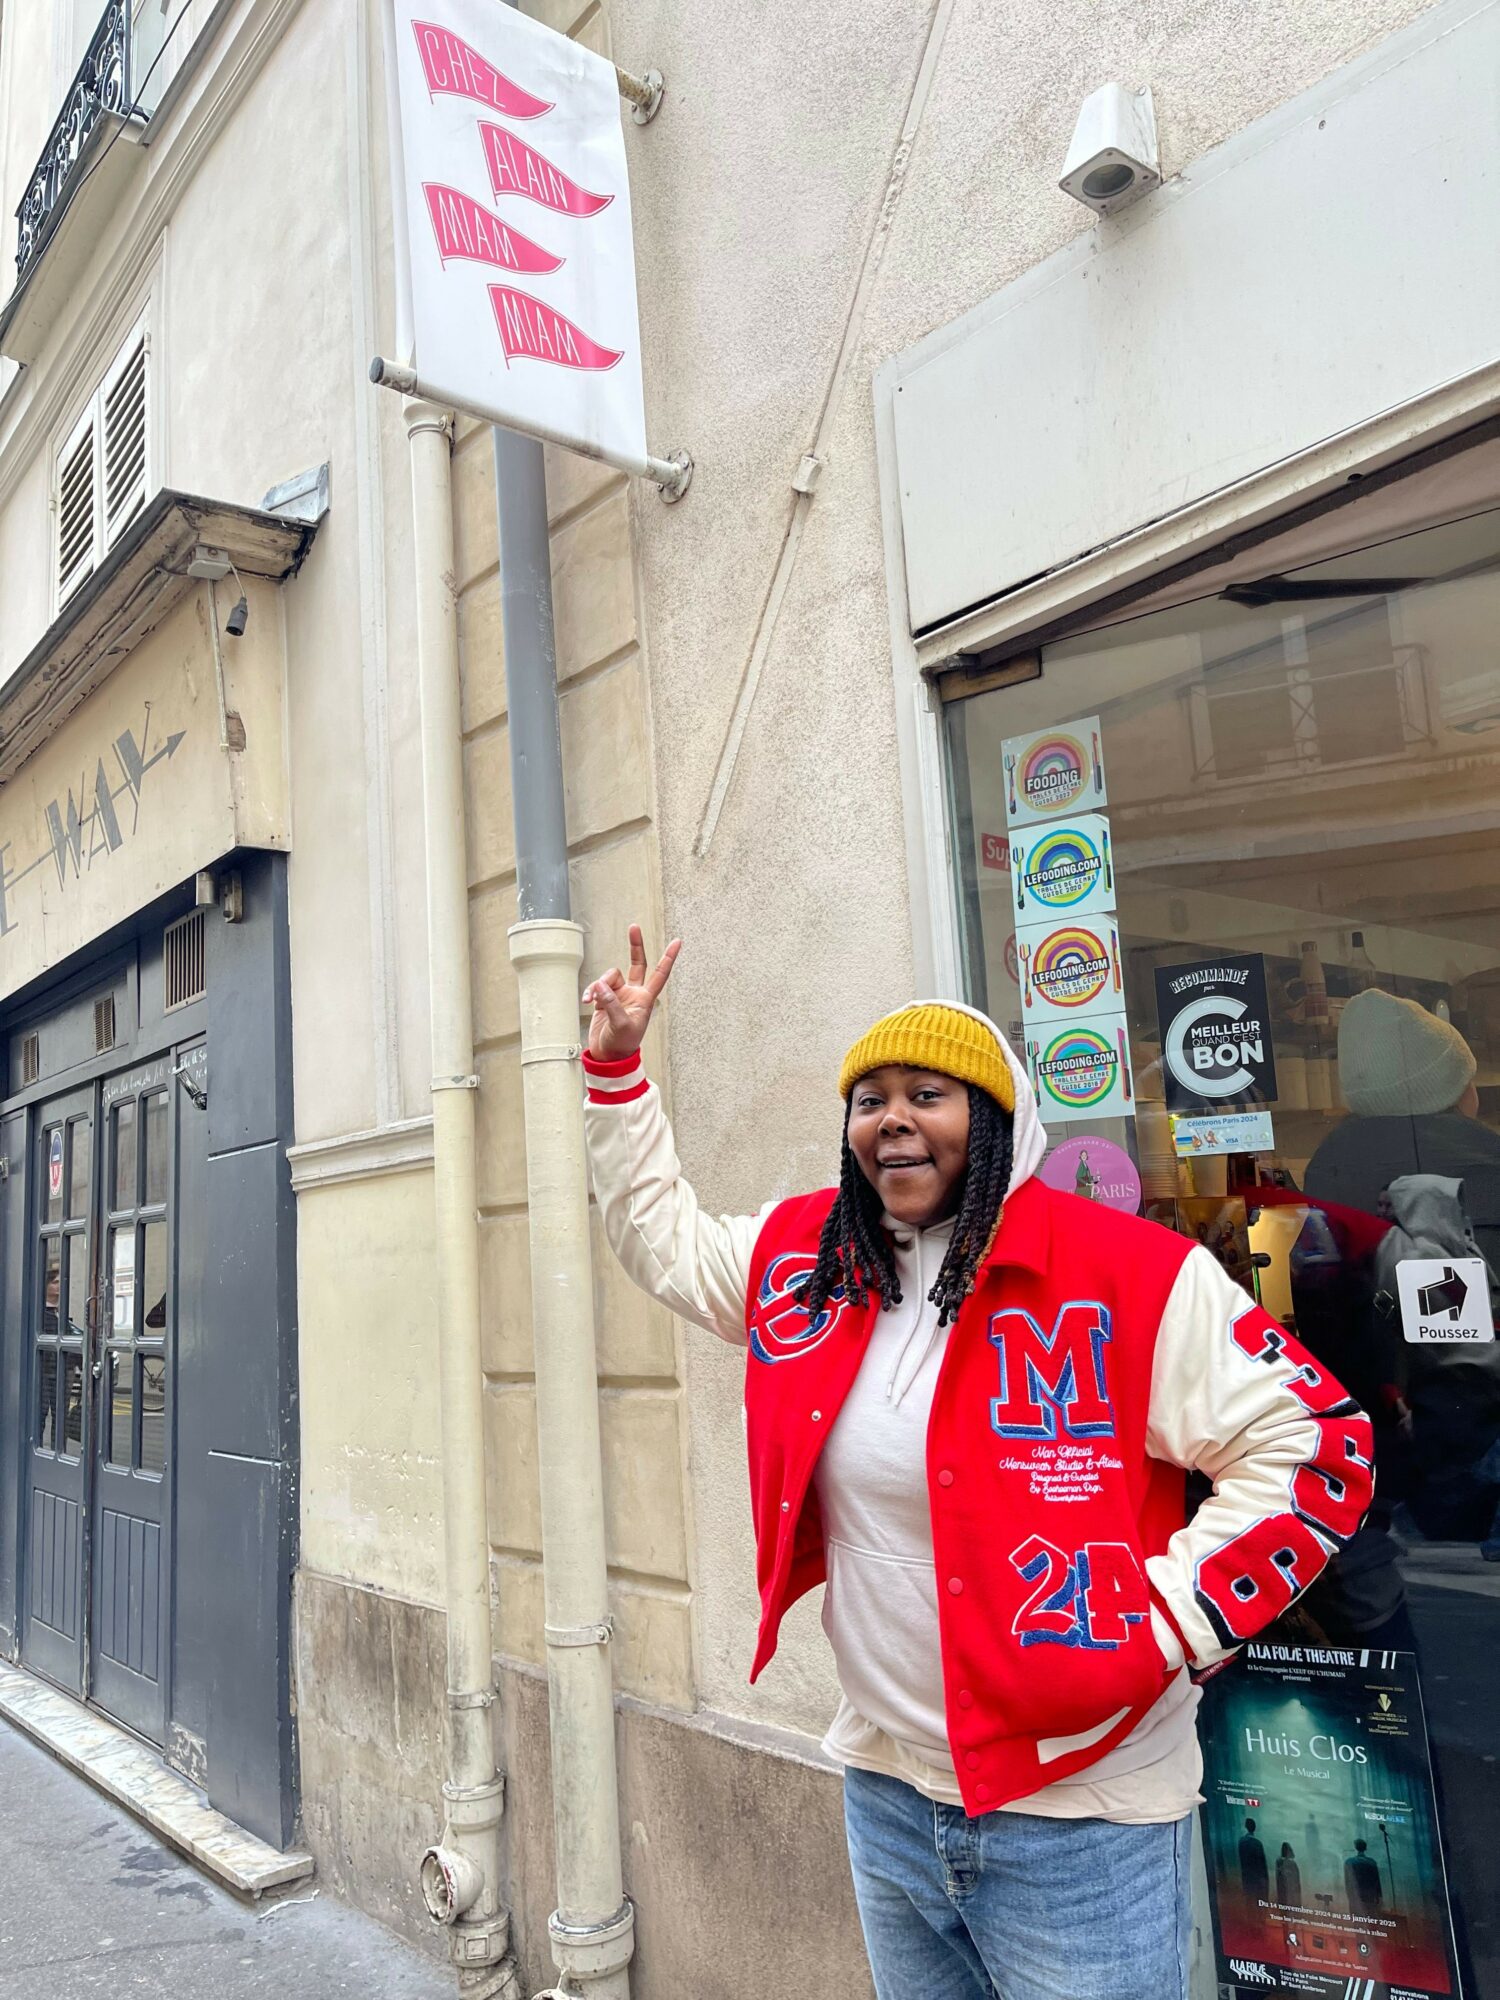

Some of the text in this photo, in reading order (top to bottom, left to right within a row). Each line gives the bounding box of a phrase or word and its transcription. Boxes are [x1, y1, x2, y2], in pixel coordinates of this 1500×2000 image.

[424, 31, 505, 108] CHEZ
[492, 129, 568, 209] ALAIN
[438, 191, 519, 268] MIAM
[501, 293, 581, 364] MIAM
[1027, 770, 1078, 791] FOODING
[44, 702, 151, 893] WAY
[1034, 796, 1053, 807] GUIDE
[1026, 857, 1099, 886] LEFOODING.COM
[1037, 874, 1096, 894] TABLES DE GENRE
[1042, 884, 1082, 899] GUIDE 2020
[1033, 958, 1108, 985] LEFOODING.COM
[1045, 982, 1070, 993] TABLES
[1082, 974, 1105, 985] GENRE
[1051, 984, 1091, 998] GUIDE 2019
[1190, 1020, 1261, 1039] MEILLEUR
[1192, 1031, 1261, 1048] QUAND C'EST
[1165, 996, 1256, 1098] C
[1192, 1040, 1265, 1070] BON
[1040, 1051, 1116, 1074] LEFOODING.COM
[1054, 1075, 1078, 1084] TABLES
[1089, 1070, 1110, 1080] GENRE
[1061, 1082, 1082, 1091] GUIDE
[1187, 1118, 1222, 1128] Célébrons
[1222, 1116, 1240, 1125] Paris
[1240, 1115, 1258, 1123] 2024
[1091, 1182, 1136, 1199] PARIS
[1419, 1326, 1480, 1339] Poussez
[988, 1300, 1116, 1441] M
[1031, 1445, 1094, 1459] Man Official
[999, 1457, 1052, 1471] Menswear
[1054, 1459, 1085, 1471] Studio
[1029, 1482, 1041, 1494] By
[1009, 1534, 1149, 1649] 24
[1247, 1643, 1257, 1659] A
[1257, 1645, 1272, 1661] LA
[1303, 1648, 1356, 1666] THEATRE
[1245, 1727, 1368, 1764] Huis Clos
[1284, 1766, 1330, 1780] Le Musical
[1258, 1899, 1269, 1908] Du
[1269, 1901, 1278, 1909] 14
[1278, 1903, 1314, 1915] novembre
[1314, 1909, 1331, 1918] 2024
[1342, 1913, 1351, 1921] 25
[1351, 1914, 1379, 1925] janvier
[1379, 1919, 1397, 1928] 2025
